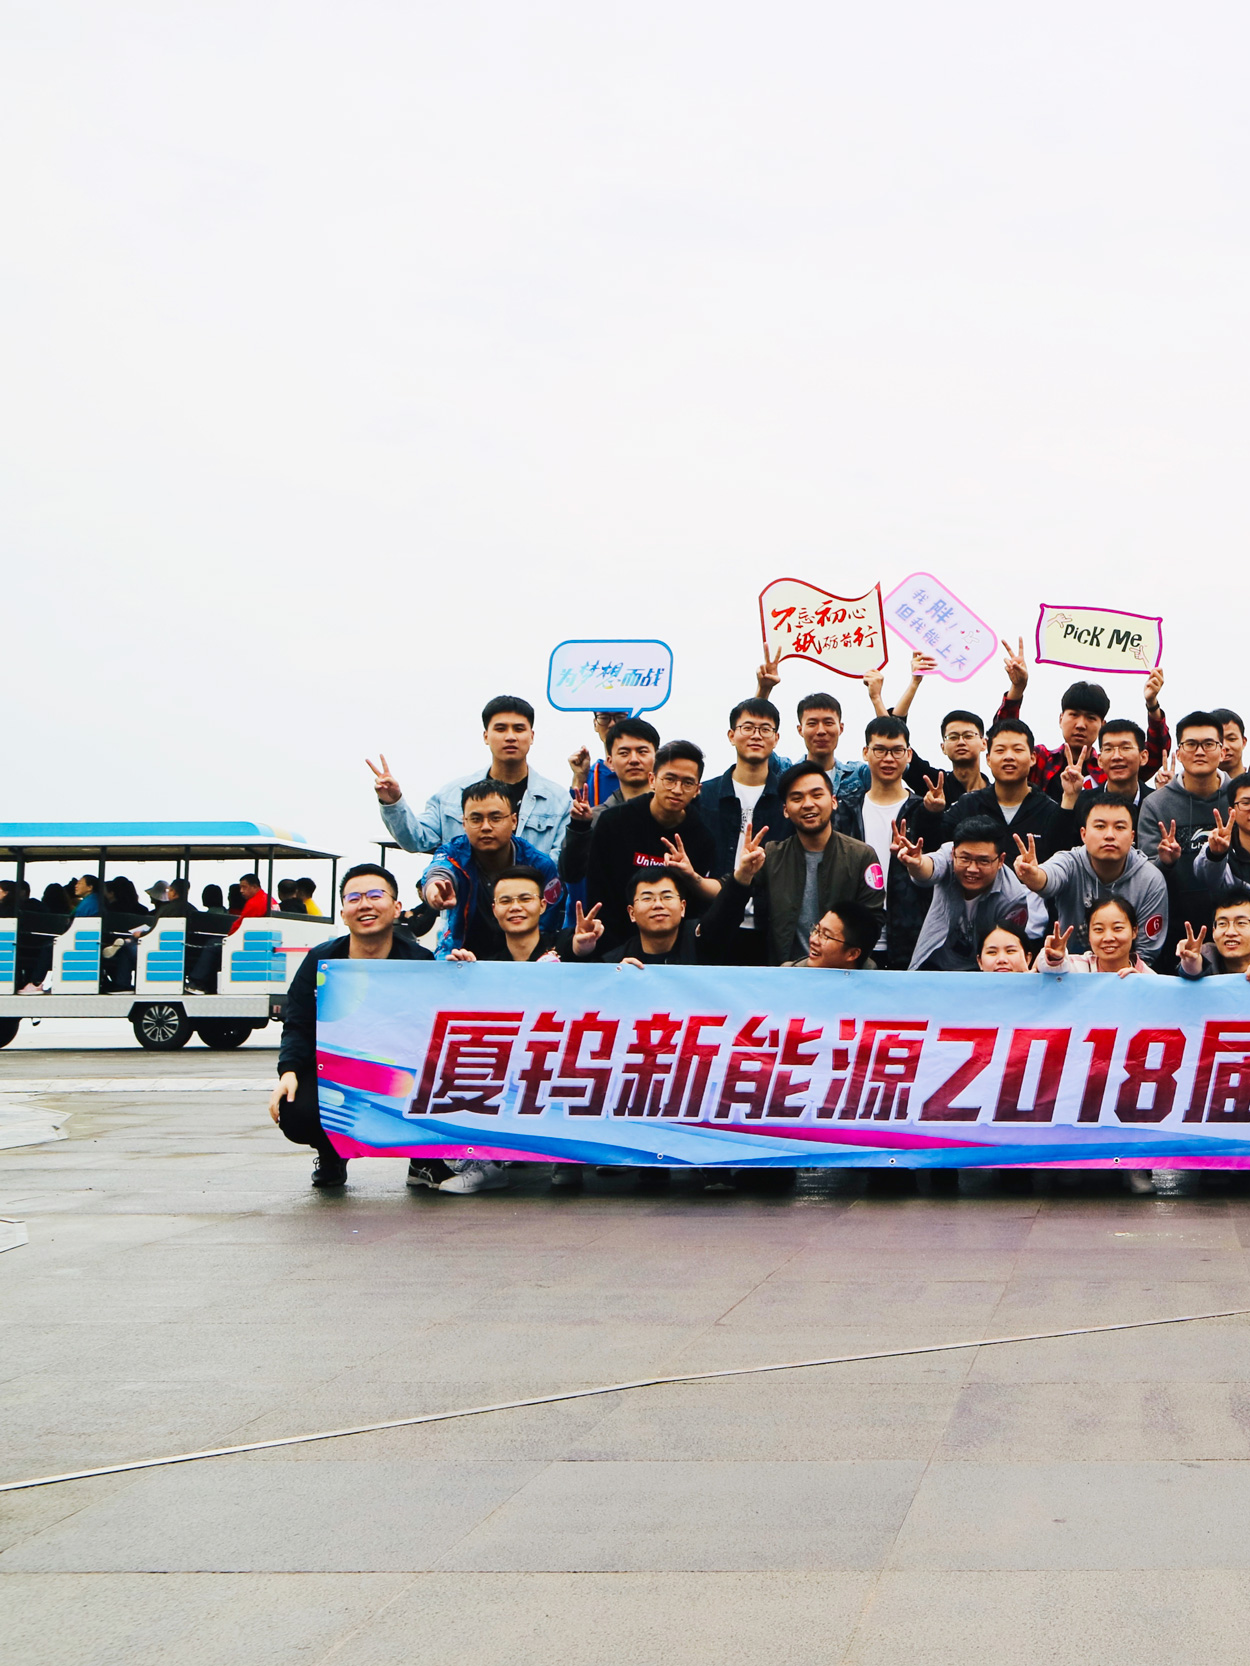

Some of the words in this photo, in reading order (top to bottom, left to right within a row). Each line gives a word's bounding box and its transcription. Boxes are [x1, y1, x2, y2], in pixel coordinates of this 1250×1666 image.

[771, 599, 866, 633] 不忘初心
[895, 603, 968, 671] 但我能上天
[1107, 628, 1142, 652] Me
[556, 660, 665, 693] 为梦想而战
